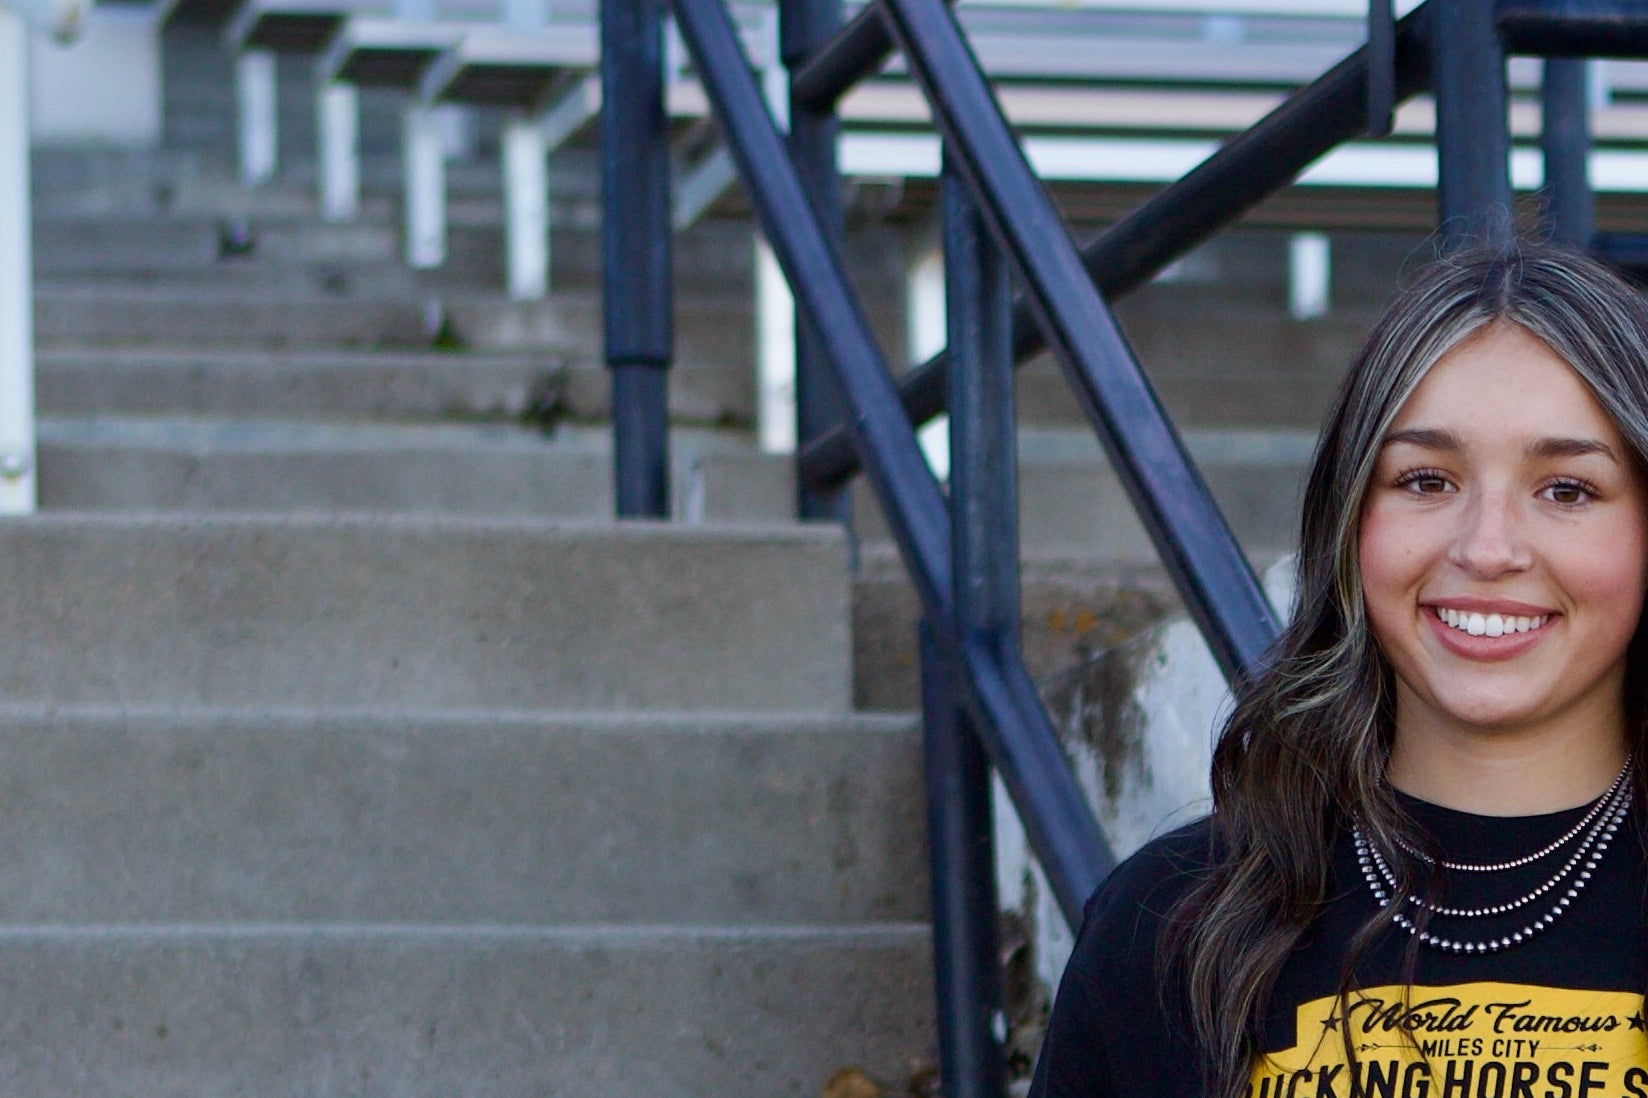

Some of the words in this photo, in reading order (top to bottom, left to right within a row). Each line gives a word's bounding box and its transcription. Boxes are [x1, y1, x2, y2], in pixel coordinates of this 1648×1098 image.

[1348, 998, 1480, 1034] World
[1484, 1000, 1621, 1034] Famous
[1421, 1038, 1483, 1058] MILES
[1492, 1039, 1540, 1058] CITY
